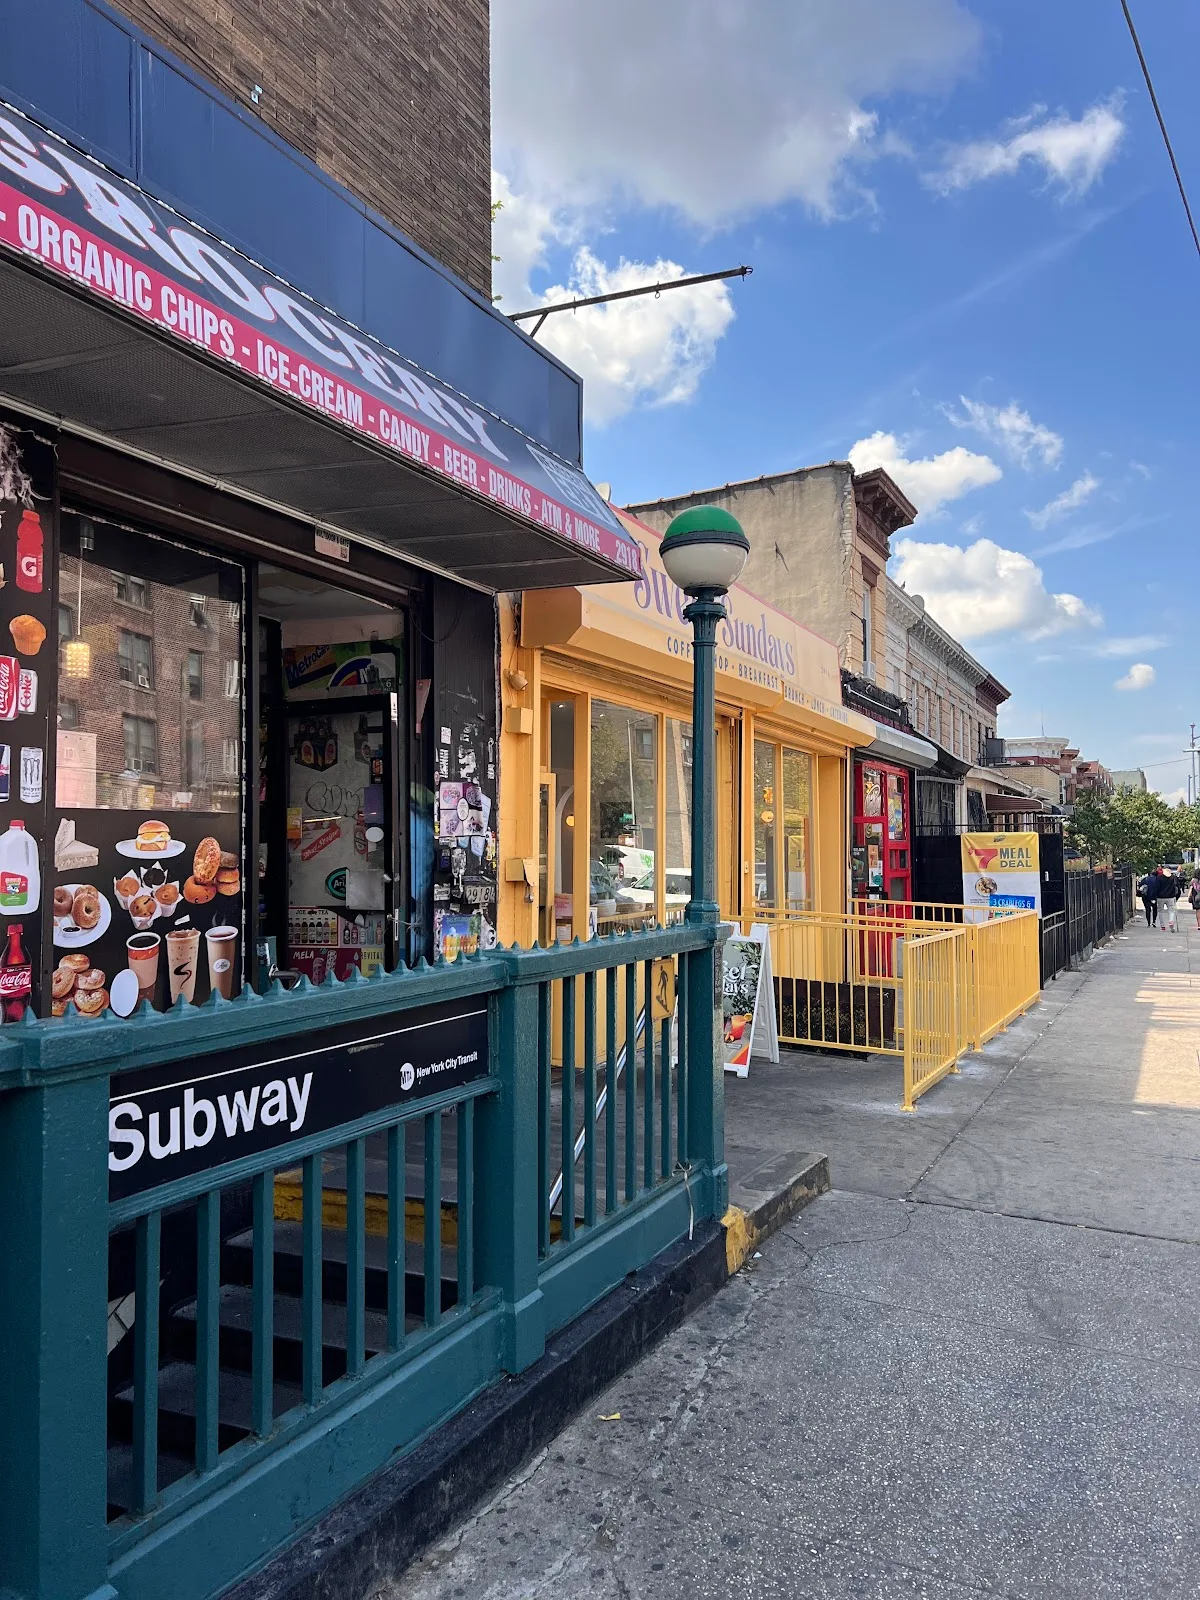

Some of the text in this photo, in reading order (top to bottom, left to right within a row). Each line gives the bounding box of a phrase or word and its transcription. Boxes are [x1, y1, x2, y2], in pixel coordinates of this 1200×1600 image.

[18, 205, 638, 572] ORGANIC CHIPS ICE-CREAM CANDY BEER DRINKS ATM & MORE 2918
[21, 556, 37, 577] G
[634, 540, 796, 677] Swe Sundays
[667, 636, 694, 659] COFF
[714, 653, 728, 671] OP
[738, 663, 779, 690] BREAKFAST
[784, 685, 805, 705] BRUNCH
[20, 675, 32, 709] Coke
[1000, 848, 1031, 859] MEAL
[1000, 860, 1032, 868] DEAL
[292, 950, 314, 960] MELA
[0, 971, 30, 987] Coca-Cola
[416, 1067, 431, 1079] New
[431, 1060, 445, 1074] York
[445, 1058, 457, 1070] City
[457, 1050, 478, 1065] Transit
[108, 1072, 313, 1171] Subway
